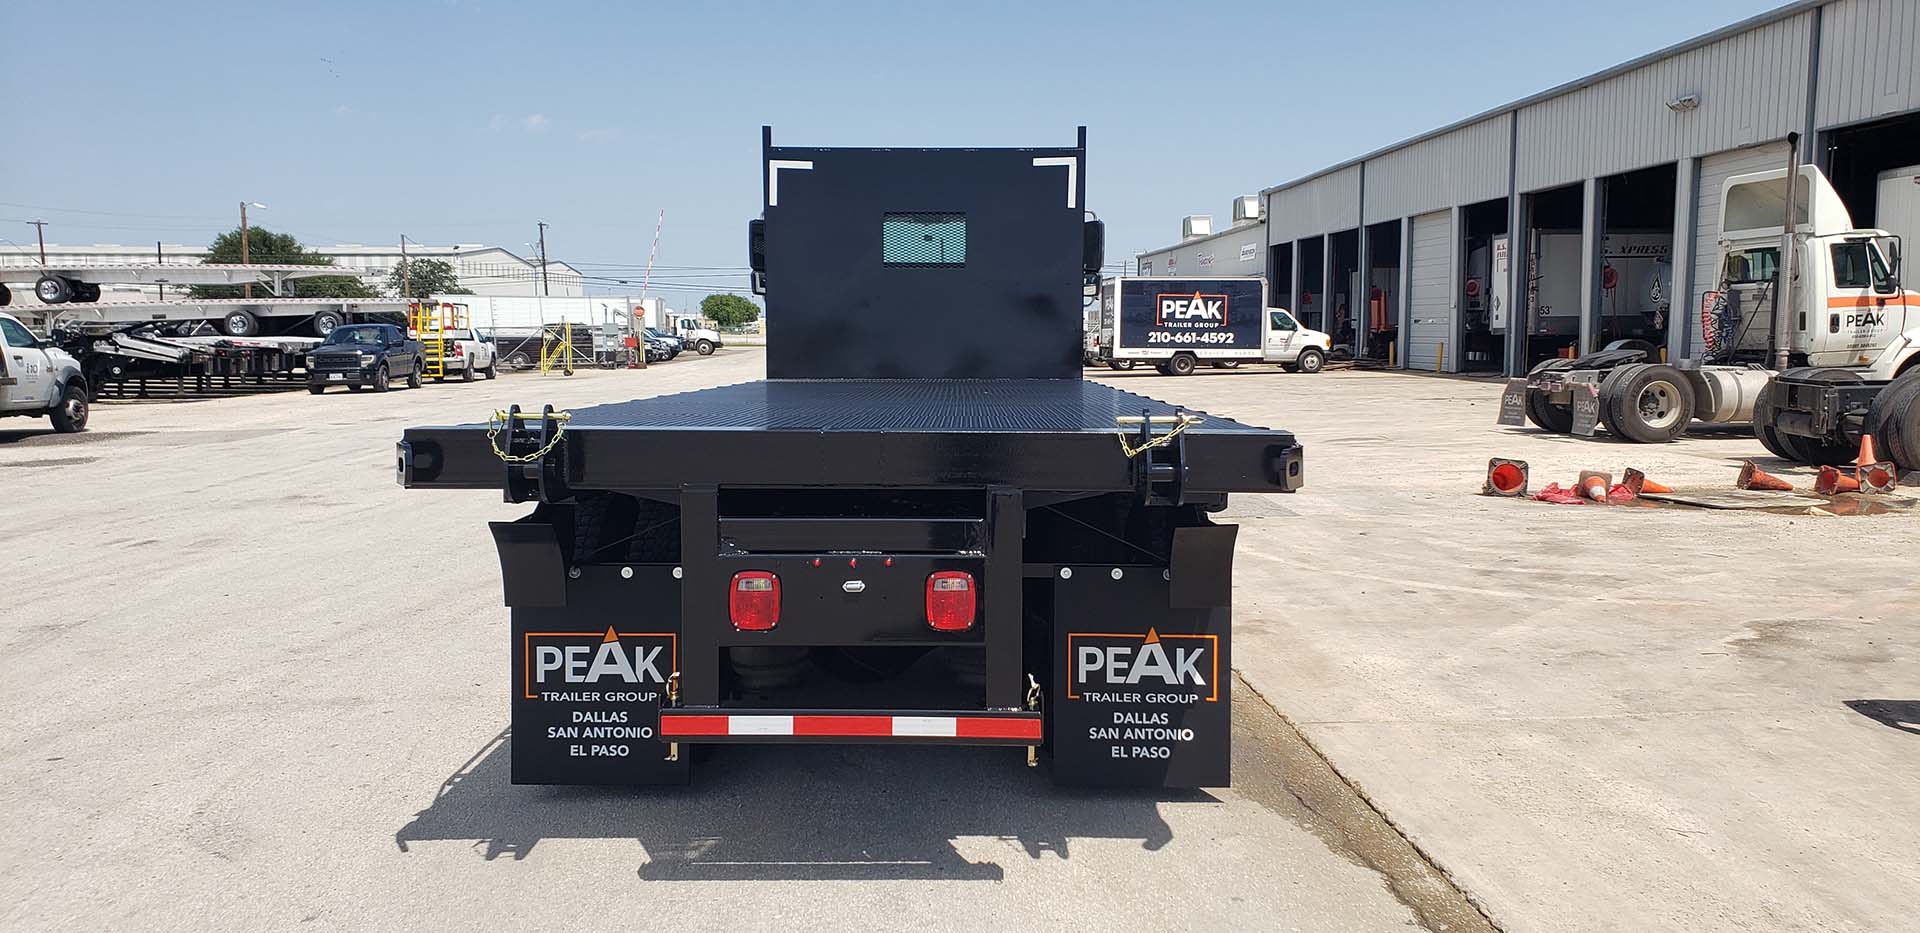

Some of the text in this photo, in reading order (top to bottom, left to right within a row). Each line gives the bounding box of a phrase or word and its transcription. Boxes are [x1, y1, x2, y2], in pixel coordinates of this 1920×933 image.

[1620, 244, 1668, 254] XPRESS
[1161, 291, 1222, 319] PEAK
[1846, 310, 1885, 327] PEAK
[1148, 331, 1234, 344] 210-661-4592
[1504, 394, 1523, 406] PEAK
[1577, 400, 1596, 413] PEAK
[536, 626, 665, 683] PEAK
[1078, 627, 1206, 686] PEAK
[541, 691, 657, 702] TRAILER GROUP
[1083, 692, 1199, 704] TRAILER GROUP
[572, 711, 628, 723] DALLAS
[1113, 712, 1169, 725] DALLAS
[547, 726, 653, 739] SAN ANTONIO
[1089, 727, 1194, 742] SAN ANTONIO
[570, 744, 630, 757] EL PASO
[1111, 746, 1170, 759] EL PASO
